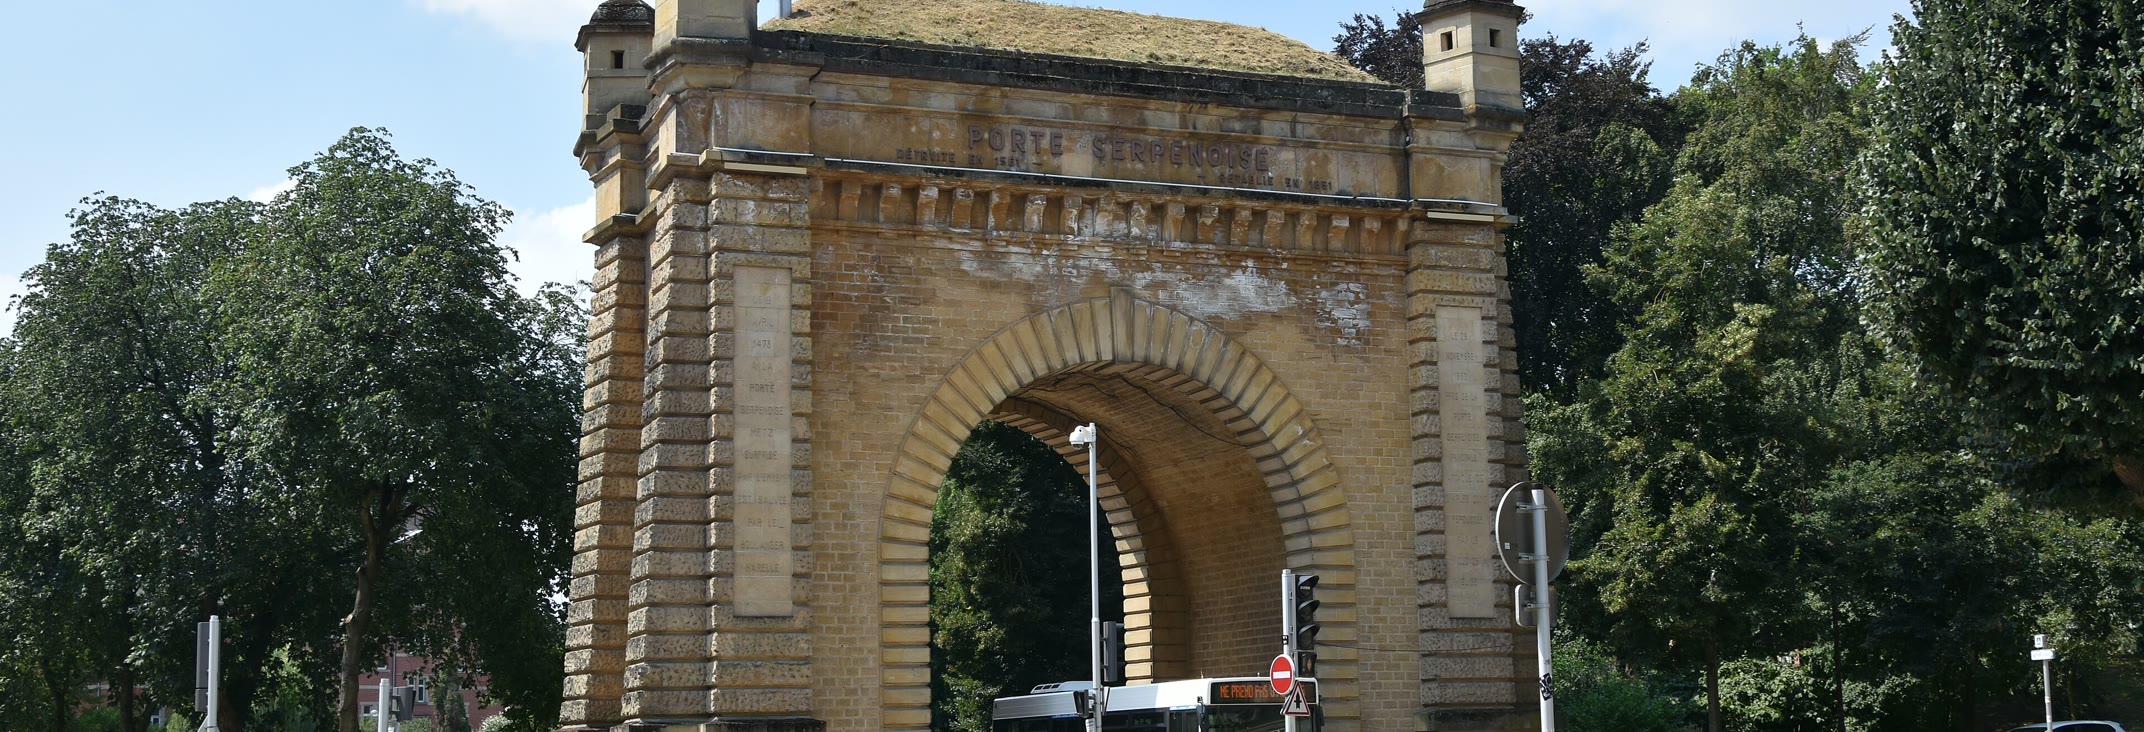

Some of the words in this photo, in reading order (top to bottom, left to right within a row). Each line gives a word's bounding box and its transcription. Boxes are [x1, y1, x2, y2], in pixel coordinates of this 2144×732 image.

[968, 126, 1064, 156] PORTE
[1092, 134, 1270, 171] SERPENOISE
[968, 153, 984, 165] EN
[1285, 177, 1300, 188] EN
[750, 383, 775, 393] PORTE
[1220, 685, 1230, 698] NE
[1231, 685, 1254, 698] PREND
[1255, 685, 1269, 698] PAS
